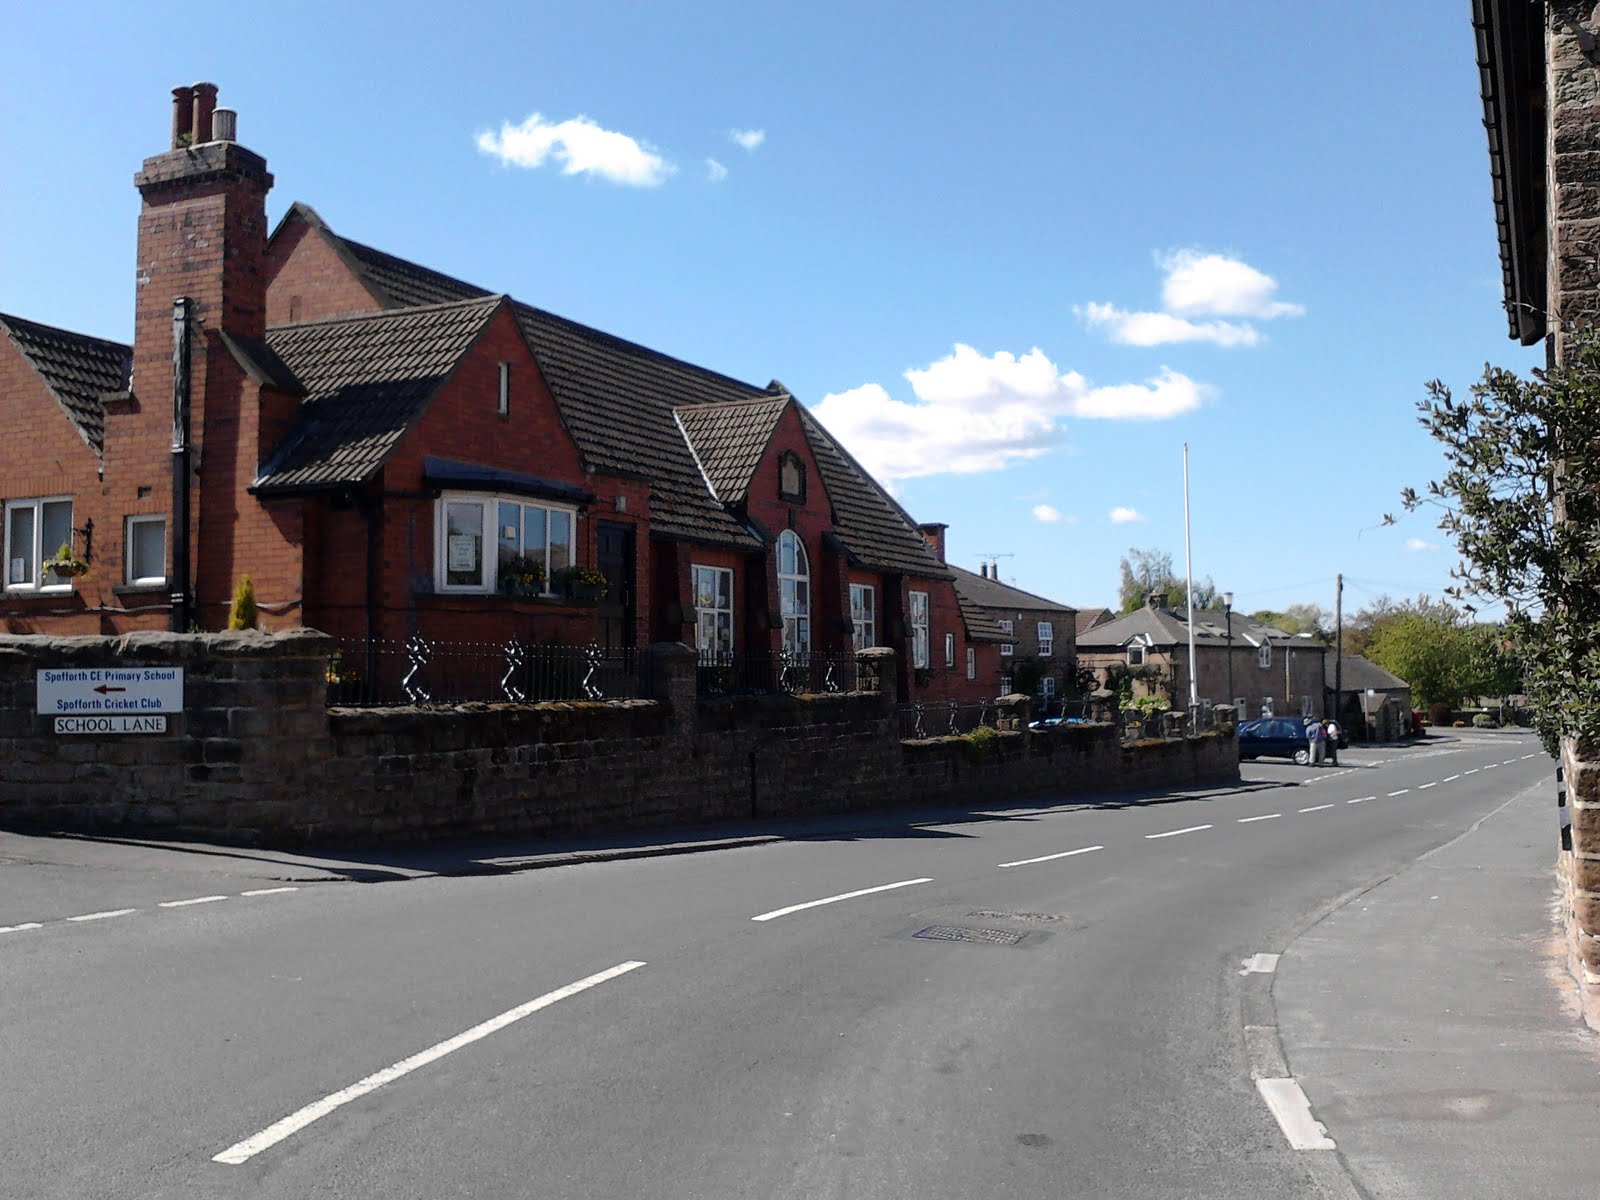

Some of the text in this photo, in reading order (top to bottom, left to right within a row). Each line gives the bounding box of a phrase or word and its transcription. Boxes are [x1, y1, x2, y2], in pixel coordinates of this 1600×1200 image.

[45, 670, 175, 683] Spofforth CE Primary School
[57, 698, 162, 711] Spofforth Cricket Club
[57, 718, 163, 731] SCHOOL LANE
